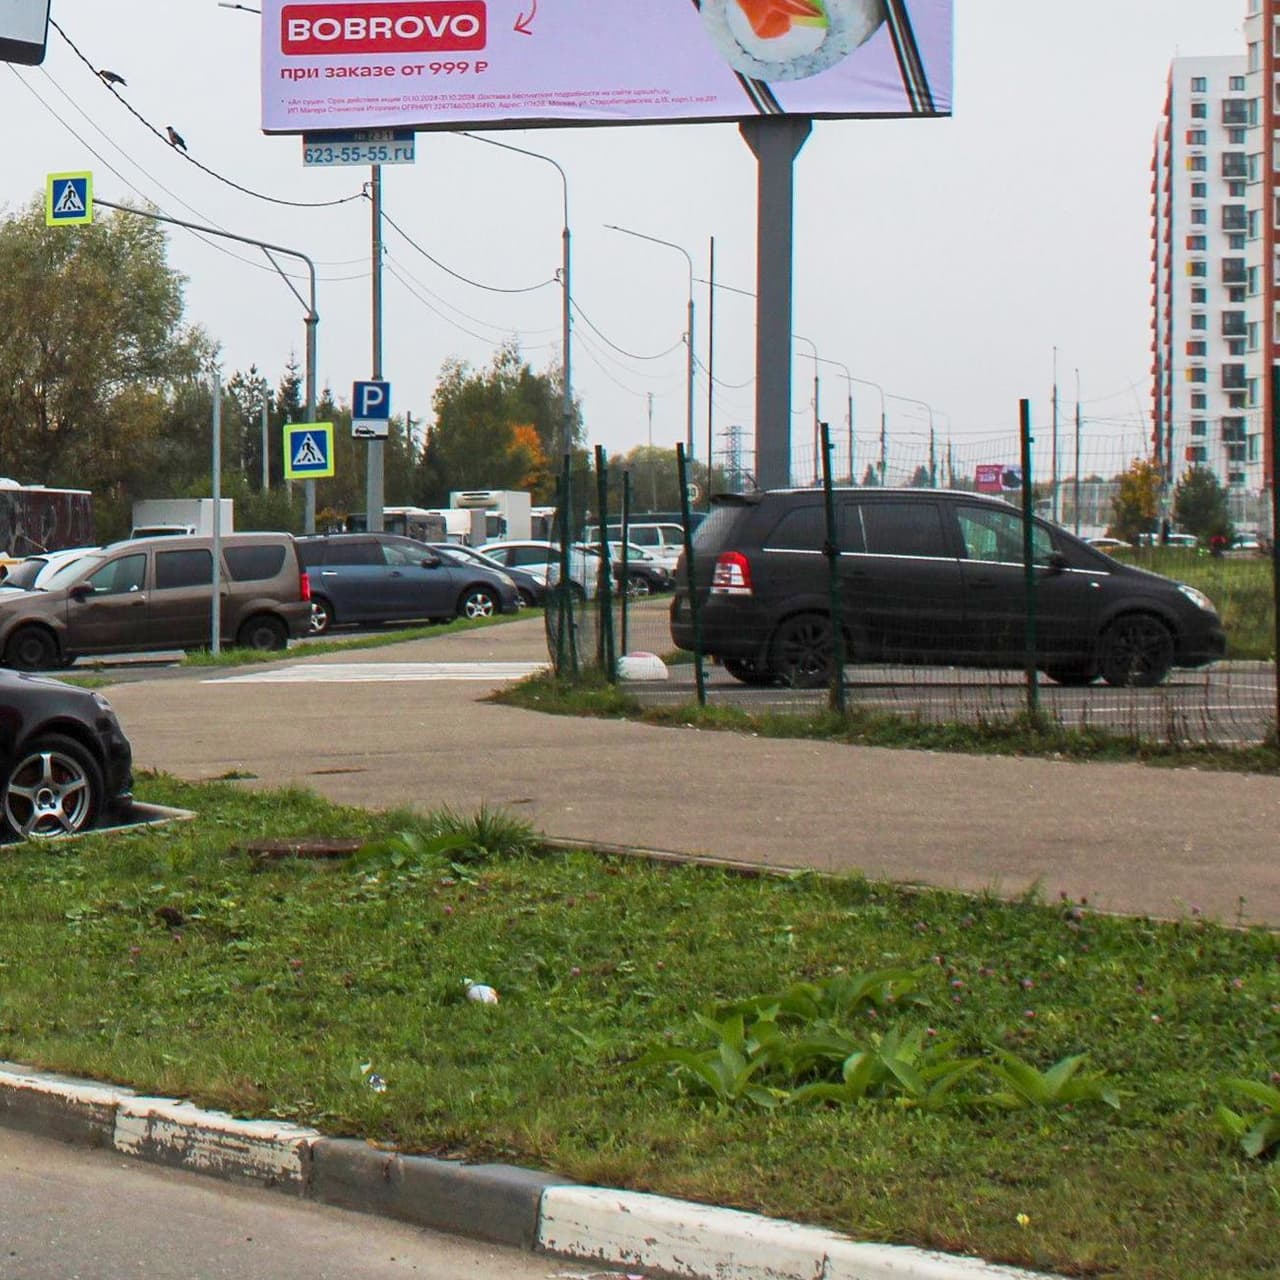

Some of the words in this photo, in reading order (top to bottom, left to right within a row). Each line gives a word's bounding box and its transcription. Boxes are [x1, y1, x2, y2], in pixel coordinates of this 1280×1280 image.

[288, 14, 480, 41] BOBROVO
[280, 67, 319, 82] при
[325, 66, 396, 78] заказе
[401, 64, 425, 76] от
[429, 61, 470, 75] 999
[304, 145, 415, 163] 623-55-55.ru
[362, 385, 383, 416] P
